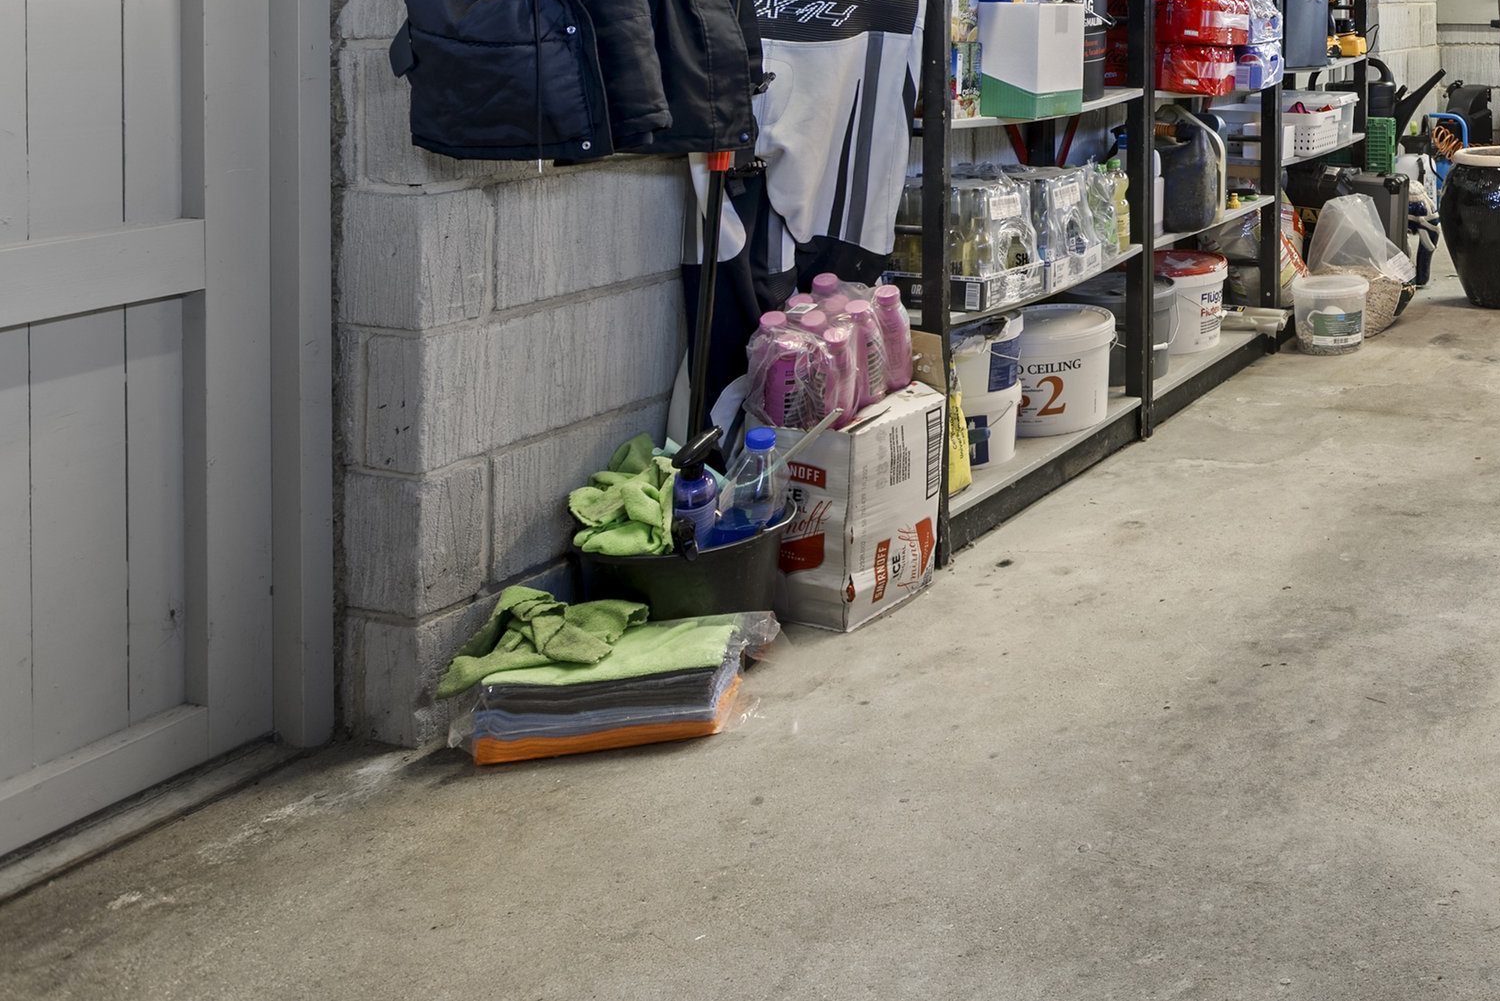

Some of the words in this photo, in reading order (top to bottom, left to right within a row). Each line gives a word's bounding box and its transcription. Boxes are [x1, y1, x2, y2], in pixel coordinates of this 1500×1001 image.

[1027, 358, 1081, 376] CEILING
[790, 464, 821, 483] NOFF
[786, 500, 832, 539] noff
[875, 546, 888, 599] SMIRNOFF
[892, 555, 901, 580] ICE
[897, 523, 919, 593] Smirnoff
